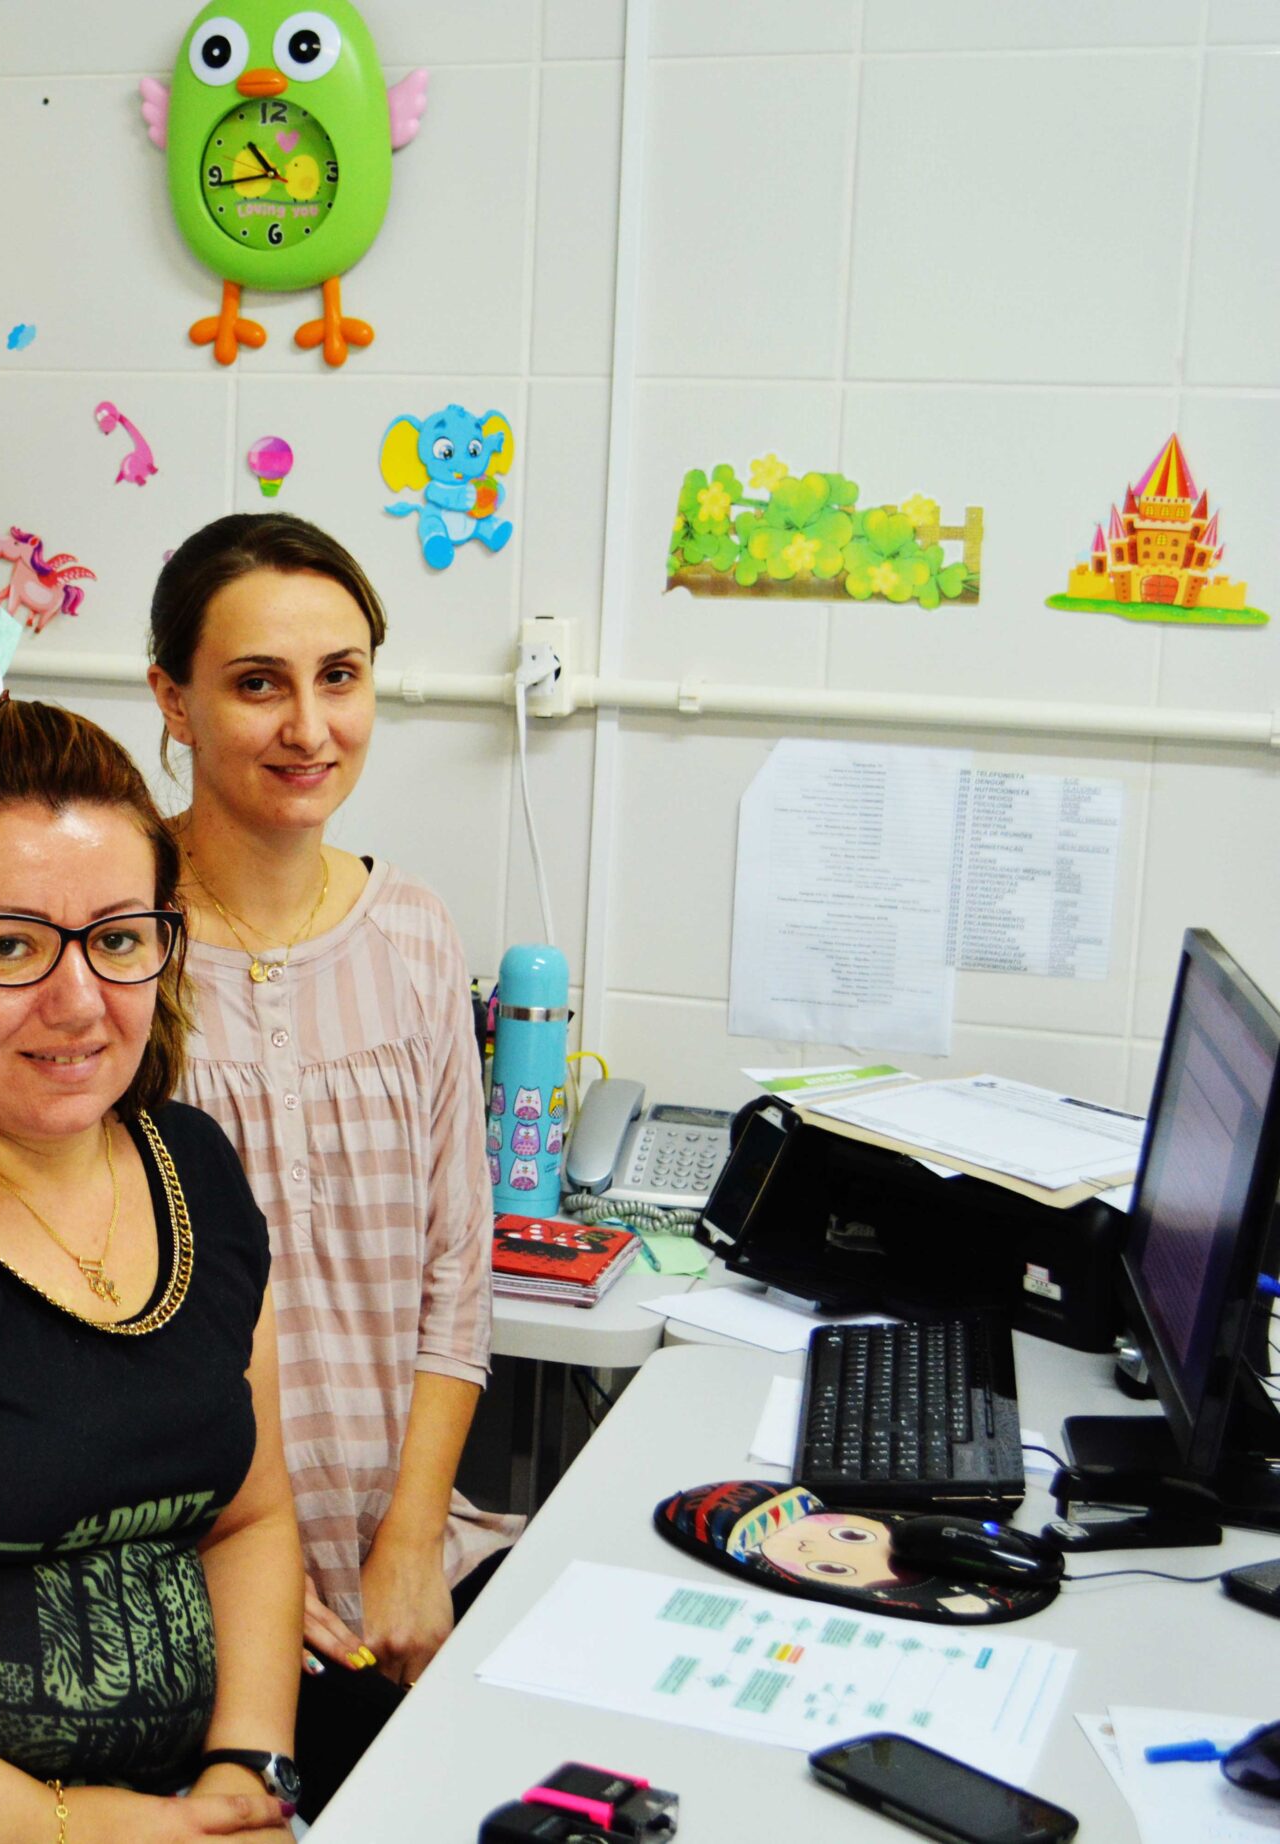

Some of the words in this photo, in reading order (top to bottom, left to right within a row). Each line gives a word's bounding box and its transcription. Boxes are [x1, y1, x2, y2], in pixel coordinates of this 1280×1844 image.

[260, 102, 288, 125] 12
[208, 165, 223, 187] 9
[268, 223, 284, 245] 6
